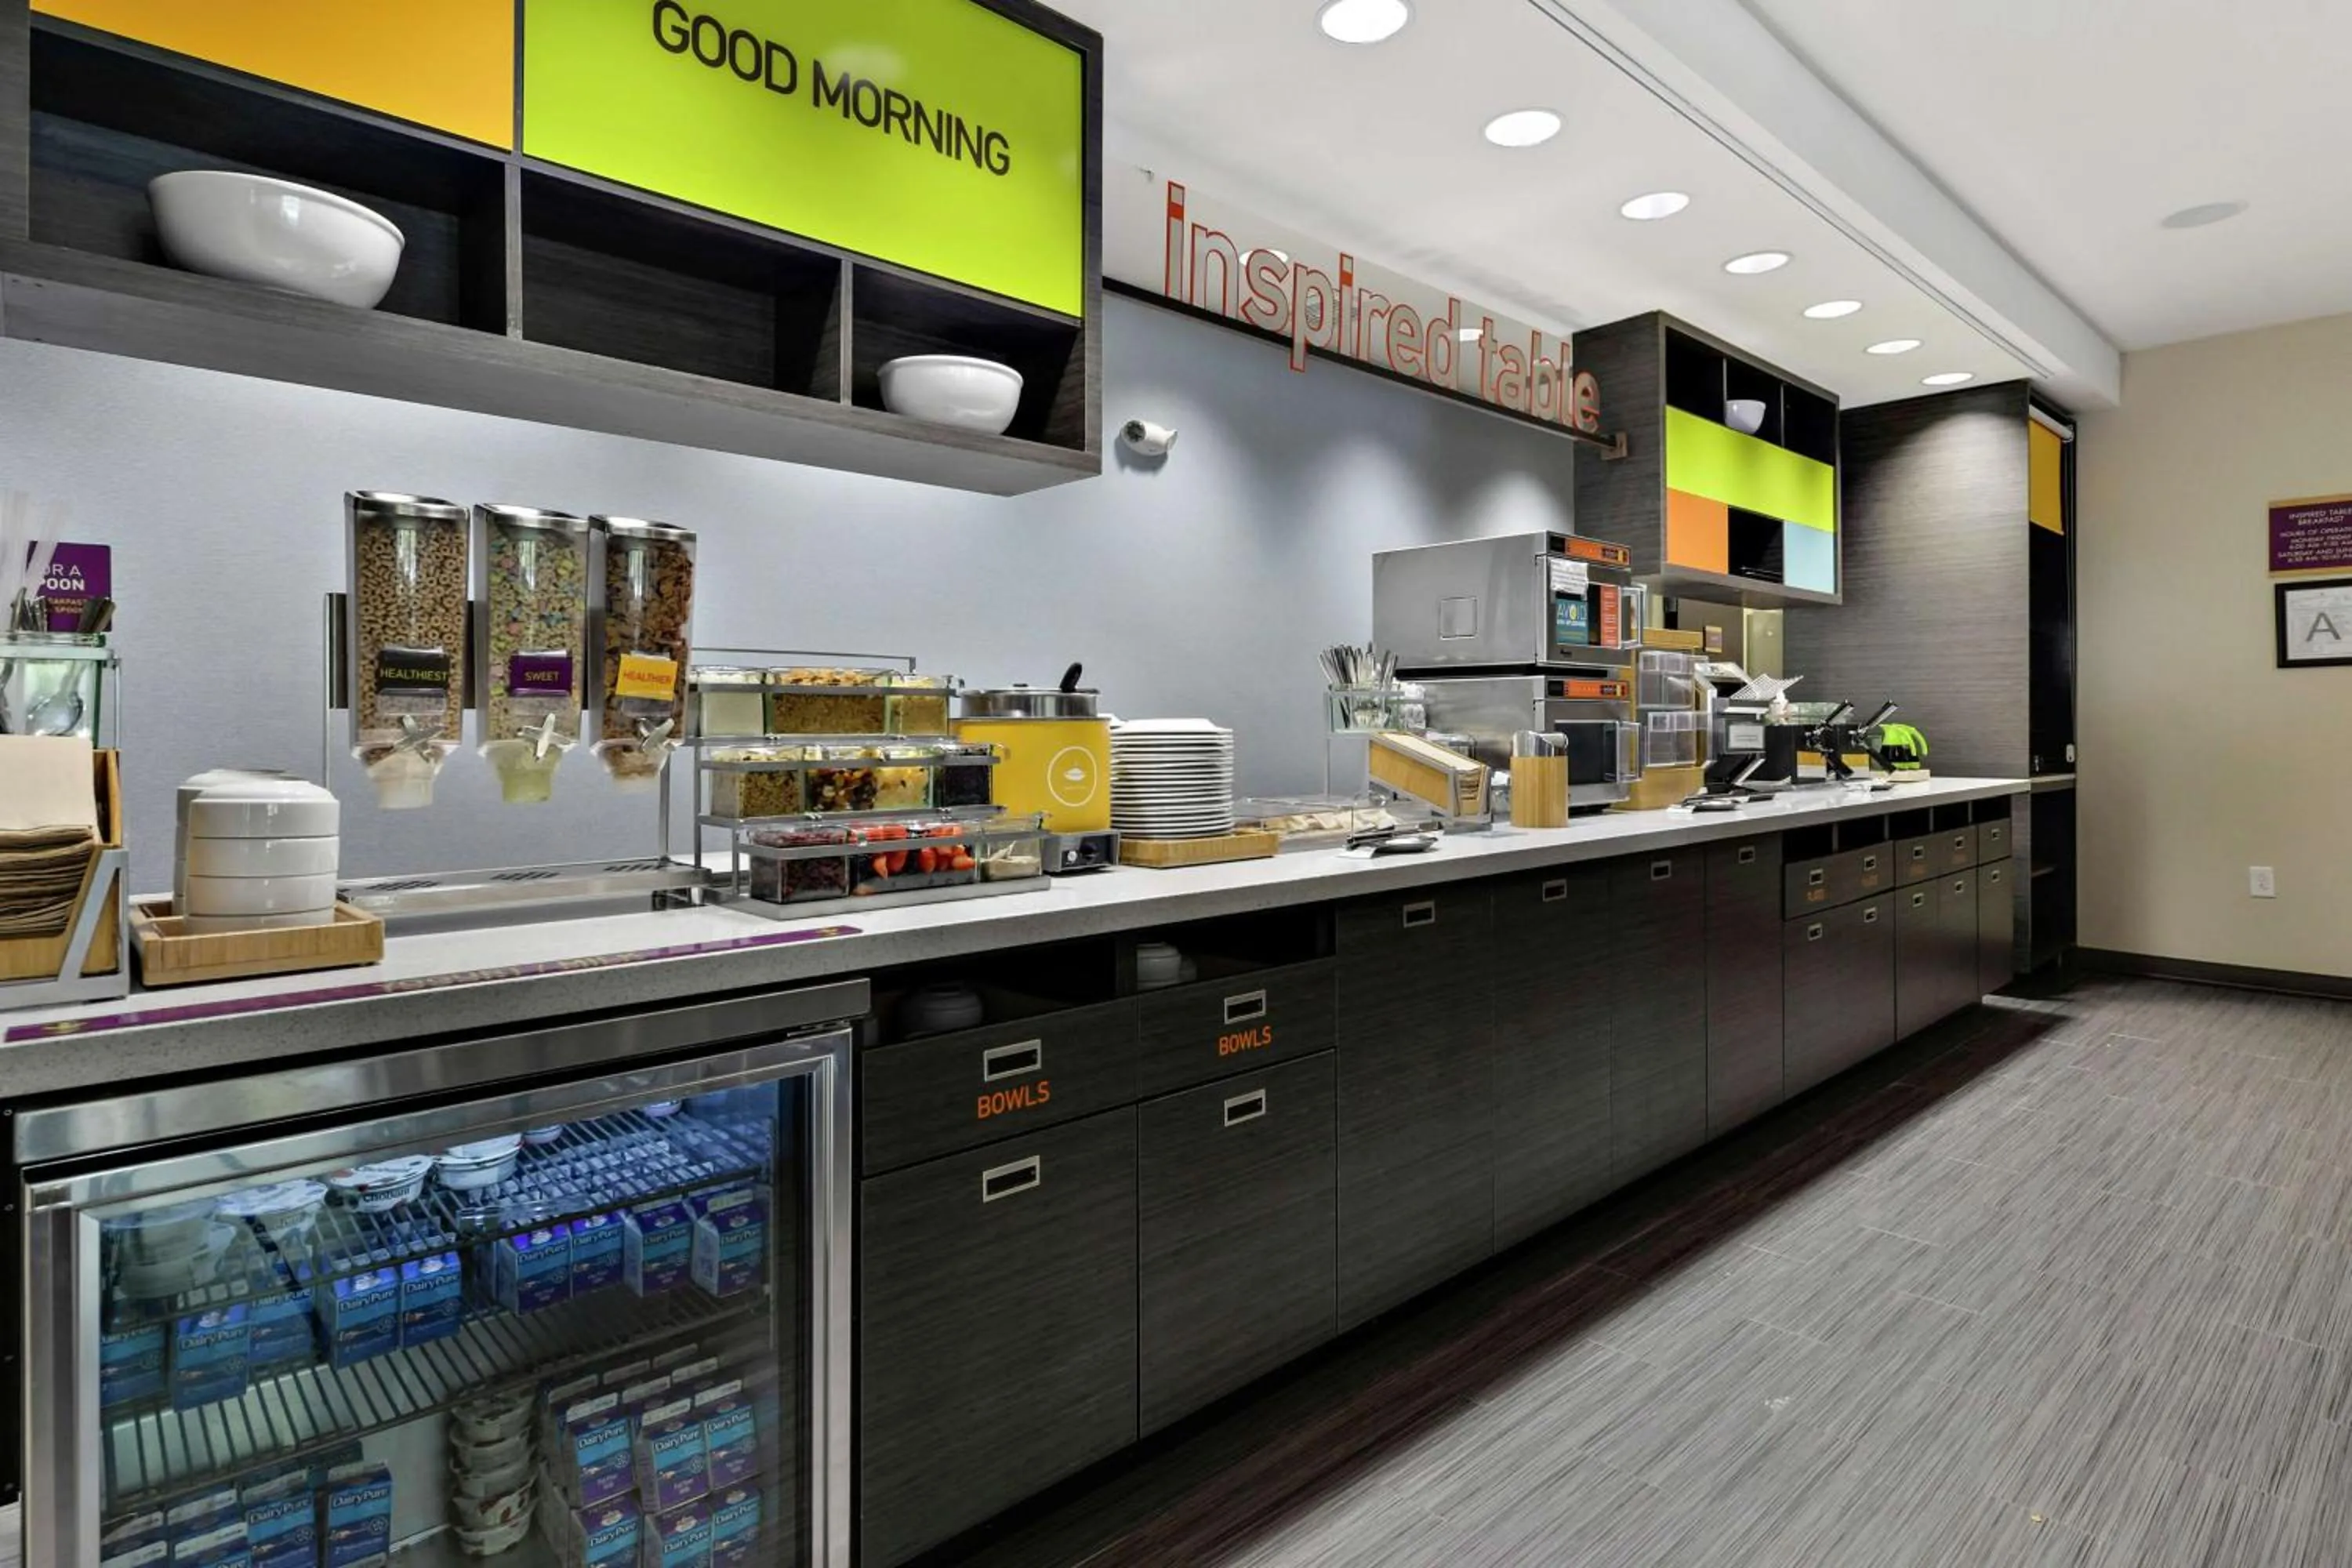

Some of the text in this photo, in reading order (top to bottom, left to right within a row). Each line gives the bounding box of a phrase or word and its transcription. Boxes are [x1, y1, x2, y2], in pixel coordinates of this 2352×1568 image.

[652, 0, 1011, 176] GOOD MORNING
[1165, 180, 1602, 434] inspired table
[69, 564, 82, 576] A
[2305, 612, 2342, 642] A
[379, 667, 448, 682] HEALTHIEST
[524, 671, 560, 683] SWEET
[623, 670, 673, 686] HEALTHIER
[1218, 1025, 1272, 1056] BOWLS
[977, 1080, 1051, 1120] BOWLS
